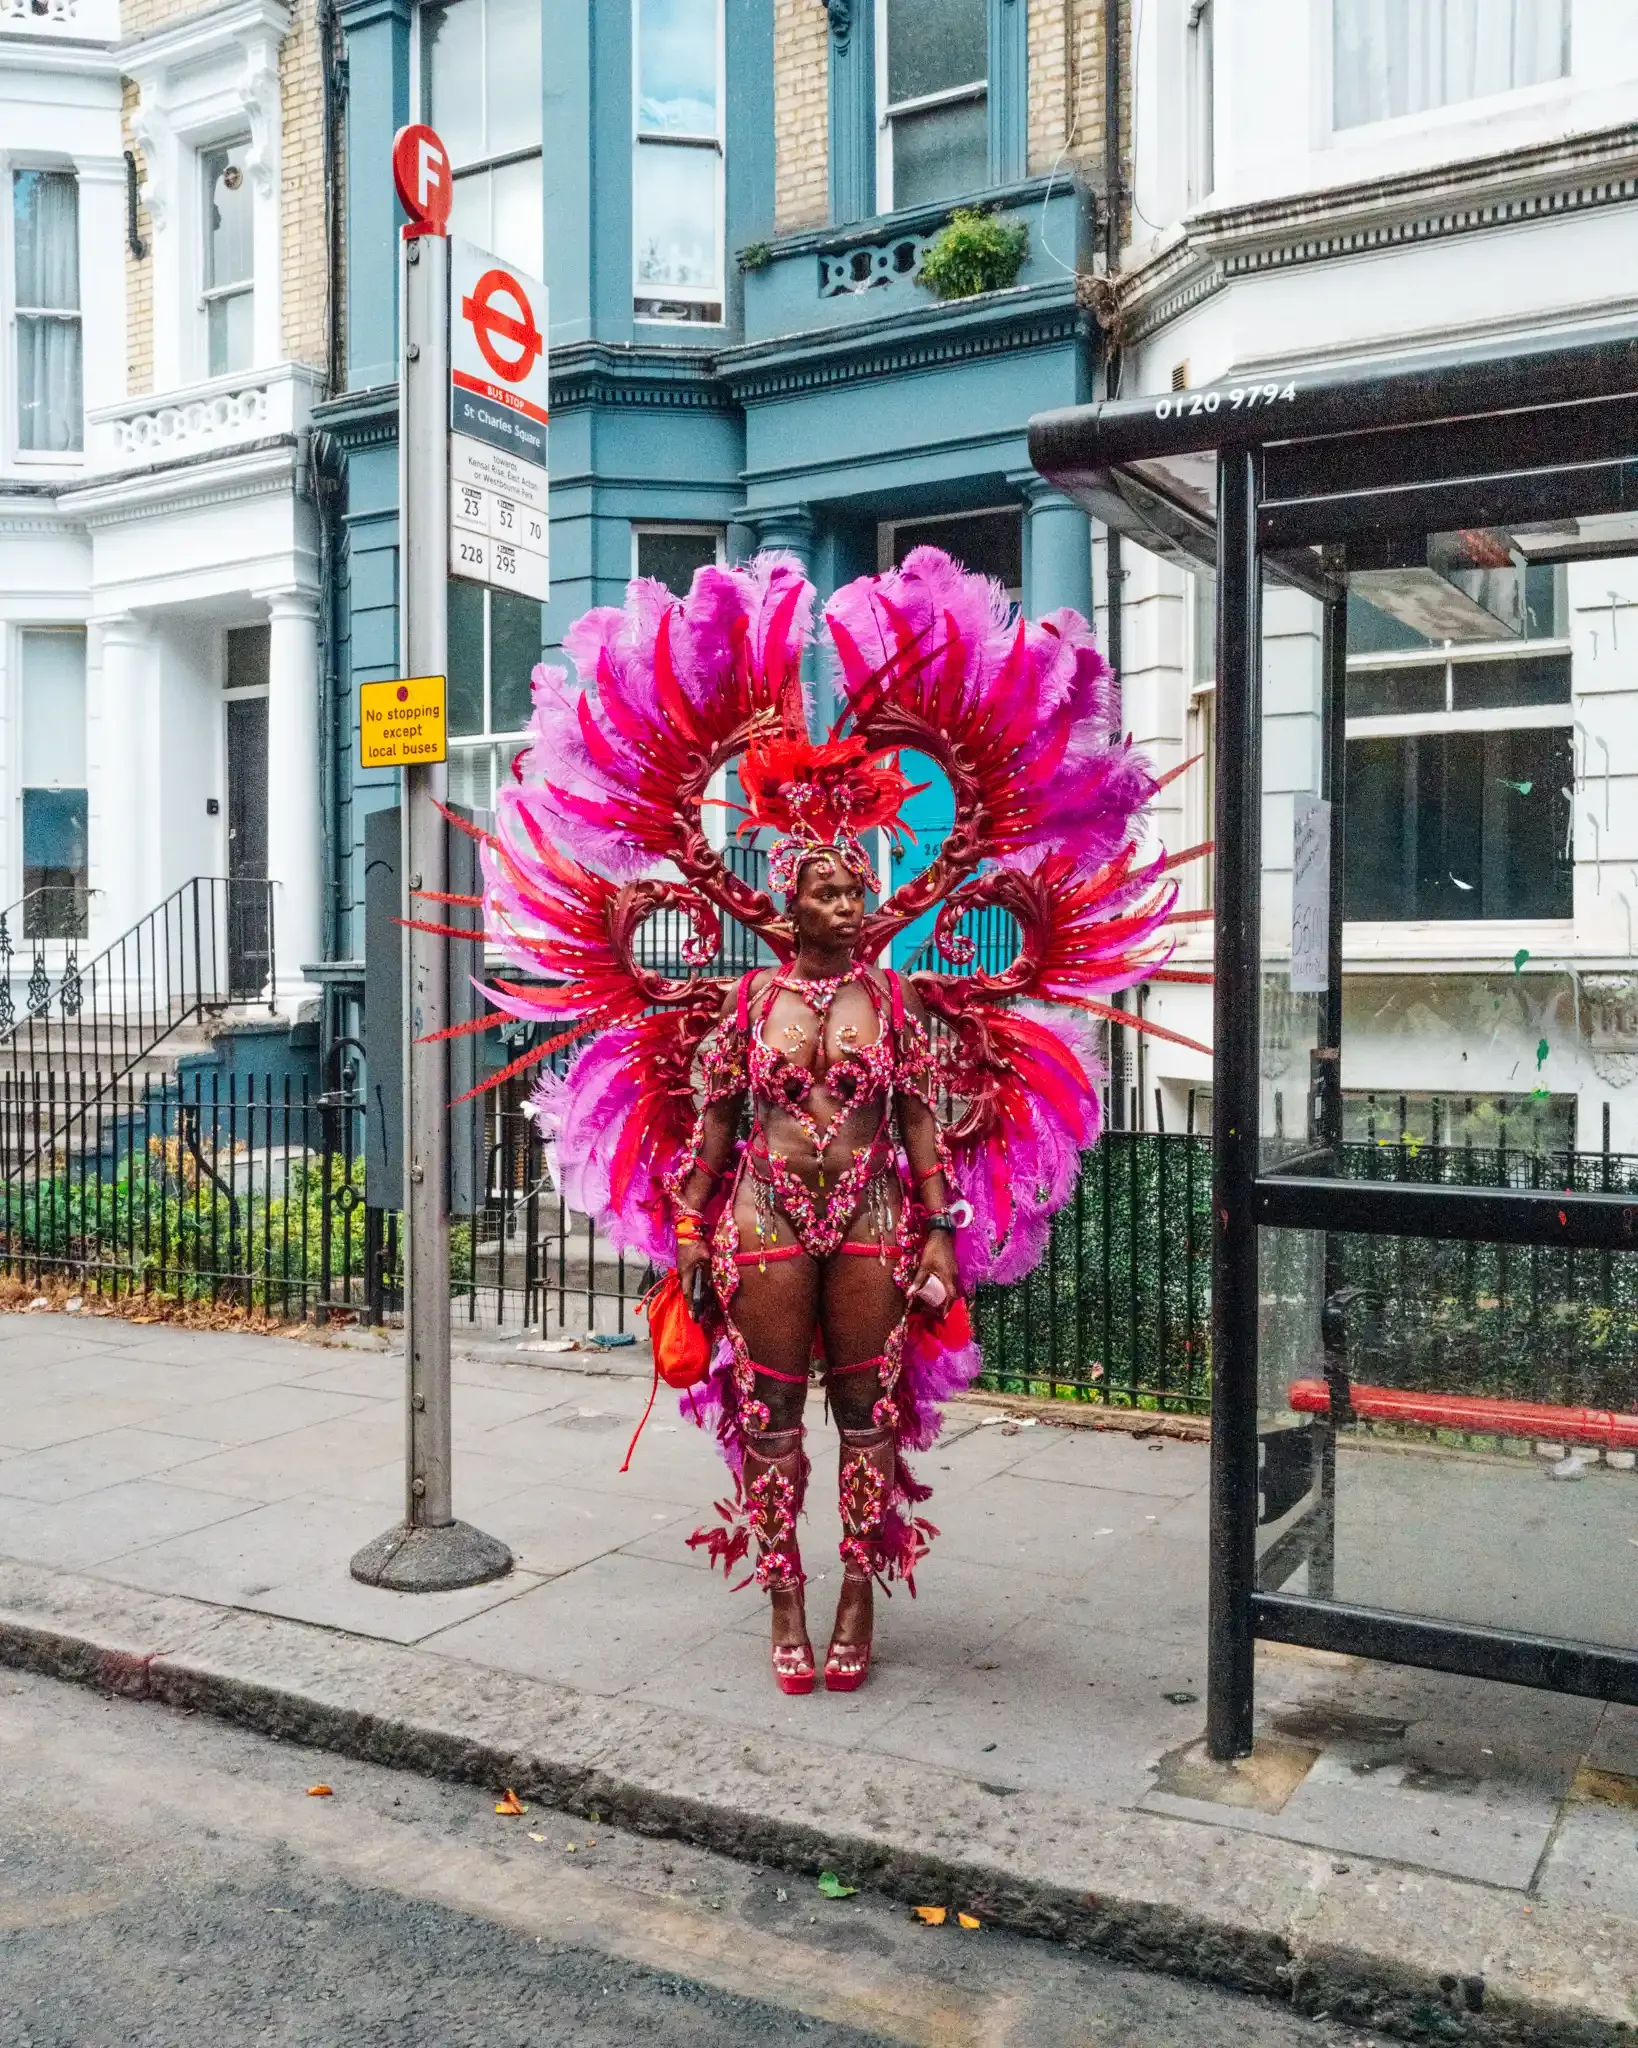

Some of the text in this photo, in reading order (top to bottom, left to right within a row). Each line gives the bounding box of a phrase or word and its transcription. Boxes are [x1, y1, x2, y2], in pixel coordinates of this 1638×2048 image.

[418, 139, 442, 206] F
[487, 386, 525, 409] BUS STOP
[1155, 380, 1296, 420] 0120 9794
[463, 403, 541, 448] St Charles Square
[468, 456, 490, 473] Kensal
[507, 471, 521, 483] East
[493, 455, 518, 472] towards
[474, 471, 481, 480] or
[483, 474, 521, 494] Westbourne
[521, 488, 534, 501] Park
[464, 498, 480, 517] 23
[499, 511, 513, 529] 52
[529, 522, 542, 540] 70
[460, 544, 483, 565] 228
[496, 555, 516, 575] 295
[366, 705, 440, 722] No stopping
[383, 724, 423, 739] except
[368, 743, 438, 758] local buses
